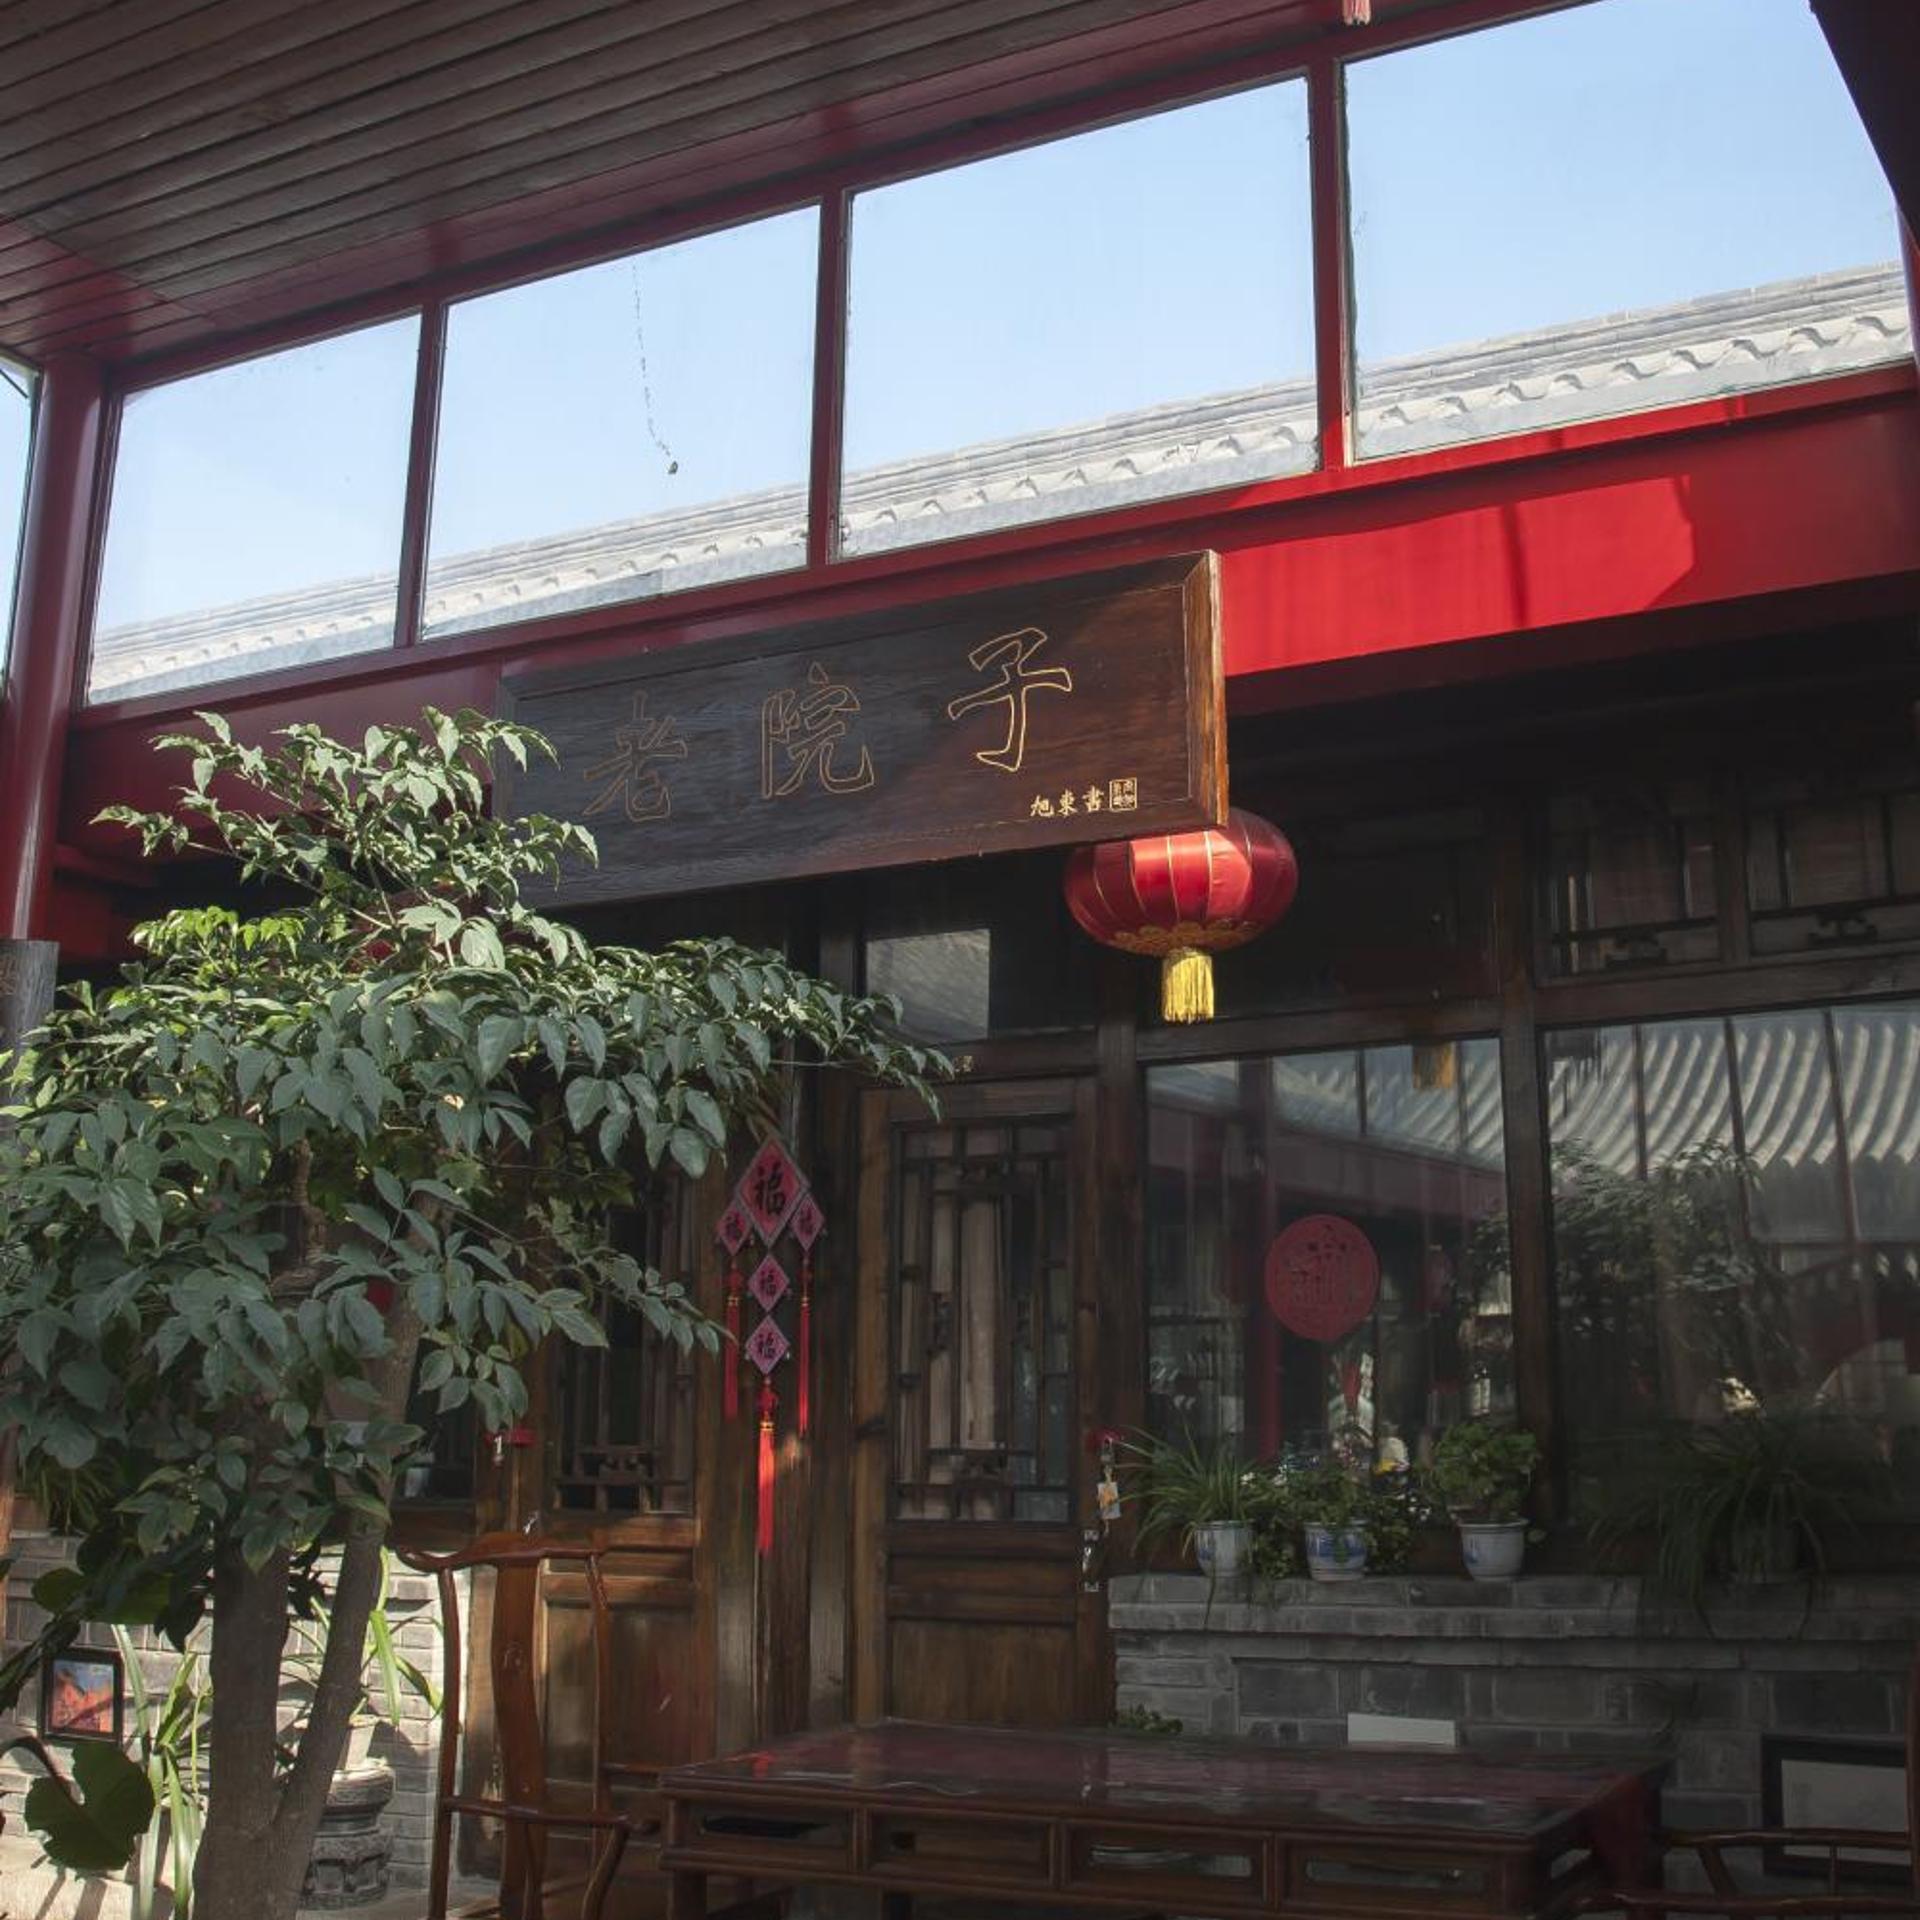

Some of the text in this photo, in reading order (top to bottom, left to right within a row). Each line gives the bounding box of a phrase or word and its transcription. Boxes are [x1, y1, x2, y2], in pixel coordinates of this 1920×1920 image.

[582, 627, 1073, 823] 老院子
[755, 1161, 786, 1216] 福
